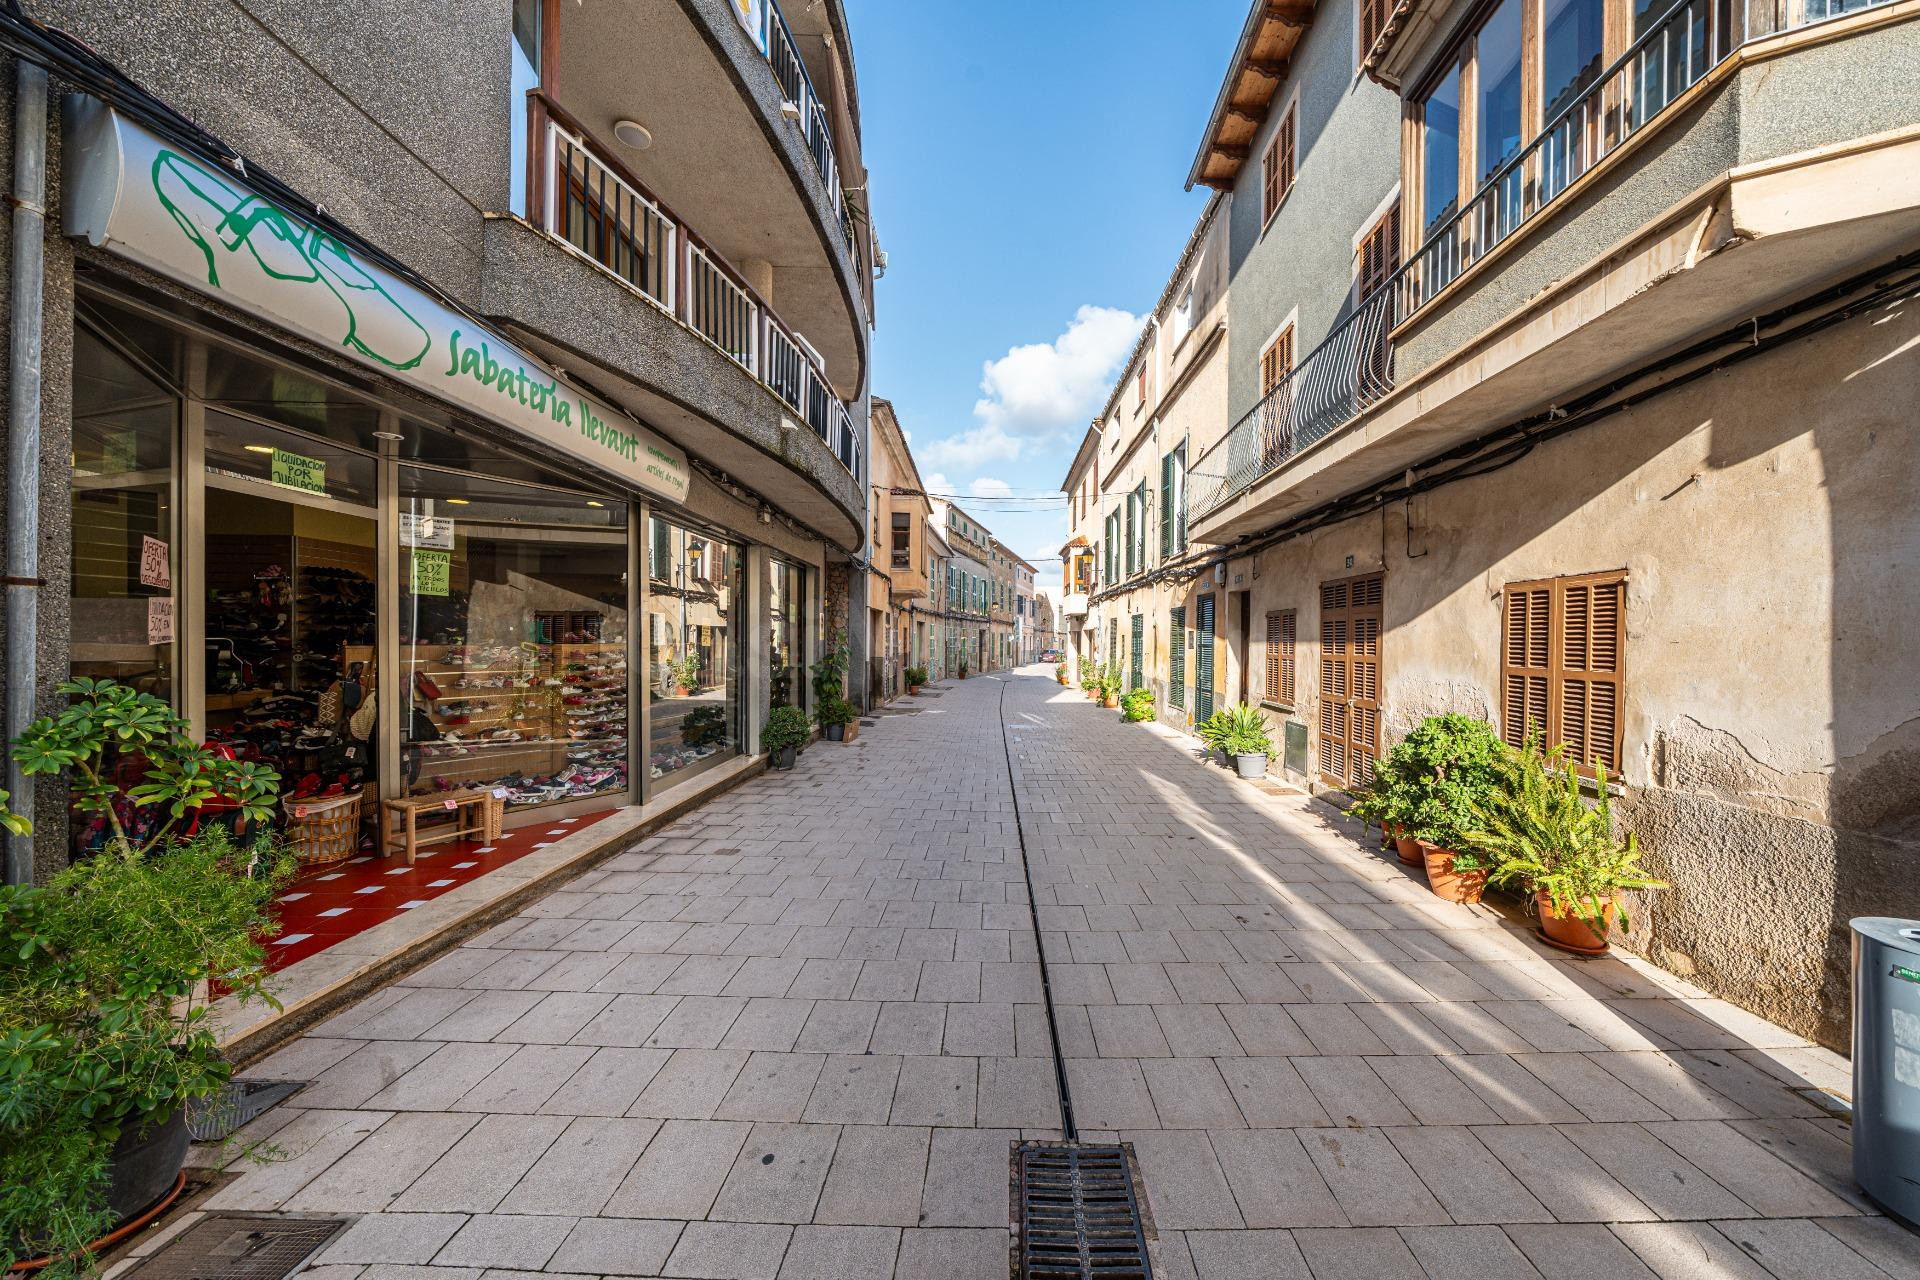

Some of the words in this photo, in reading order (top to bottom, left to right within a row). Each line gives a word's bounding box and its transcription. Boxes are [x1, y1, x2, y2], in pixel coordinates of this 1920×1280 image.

[288, 464, 312, 480] POR
[143, 540, 168, 560] OFERTA
[413, 552, 448, 564] OFERTA
[144, 555, 162, 578] 50%
[417, 561, 443, 577] 50%
